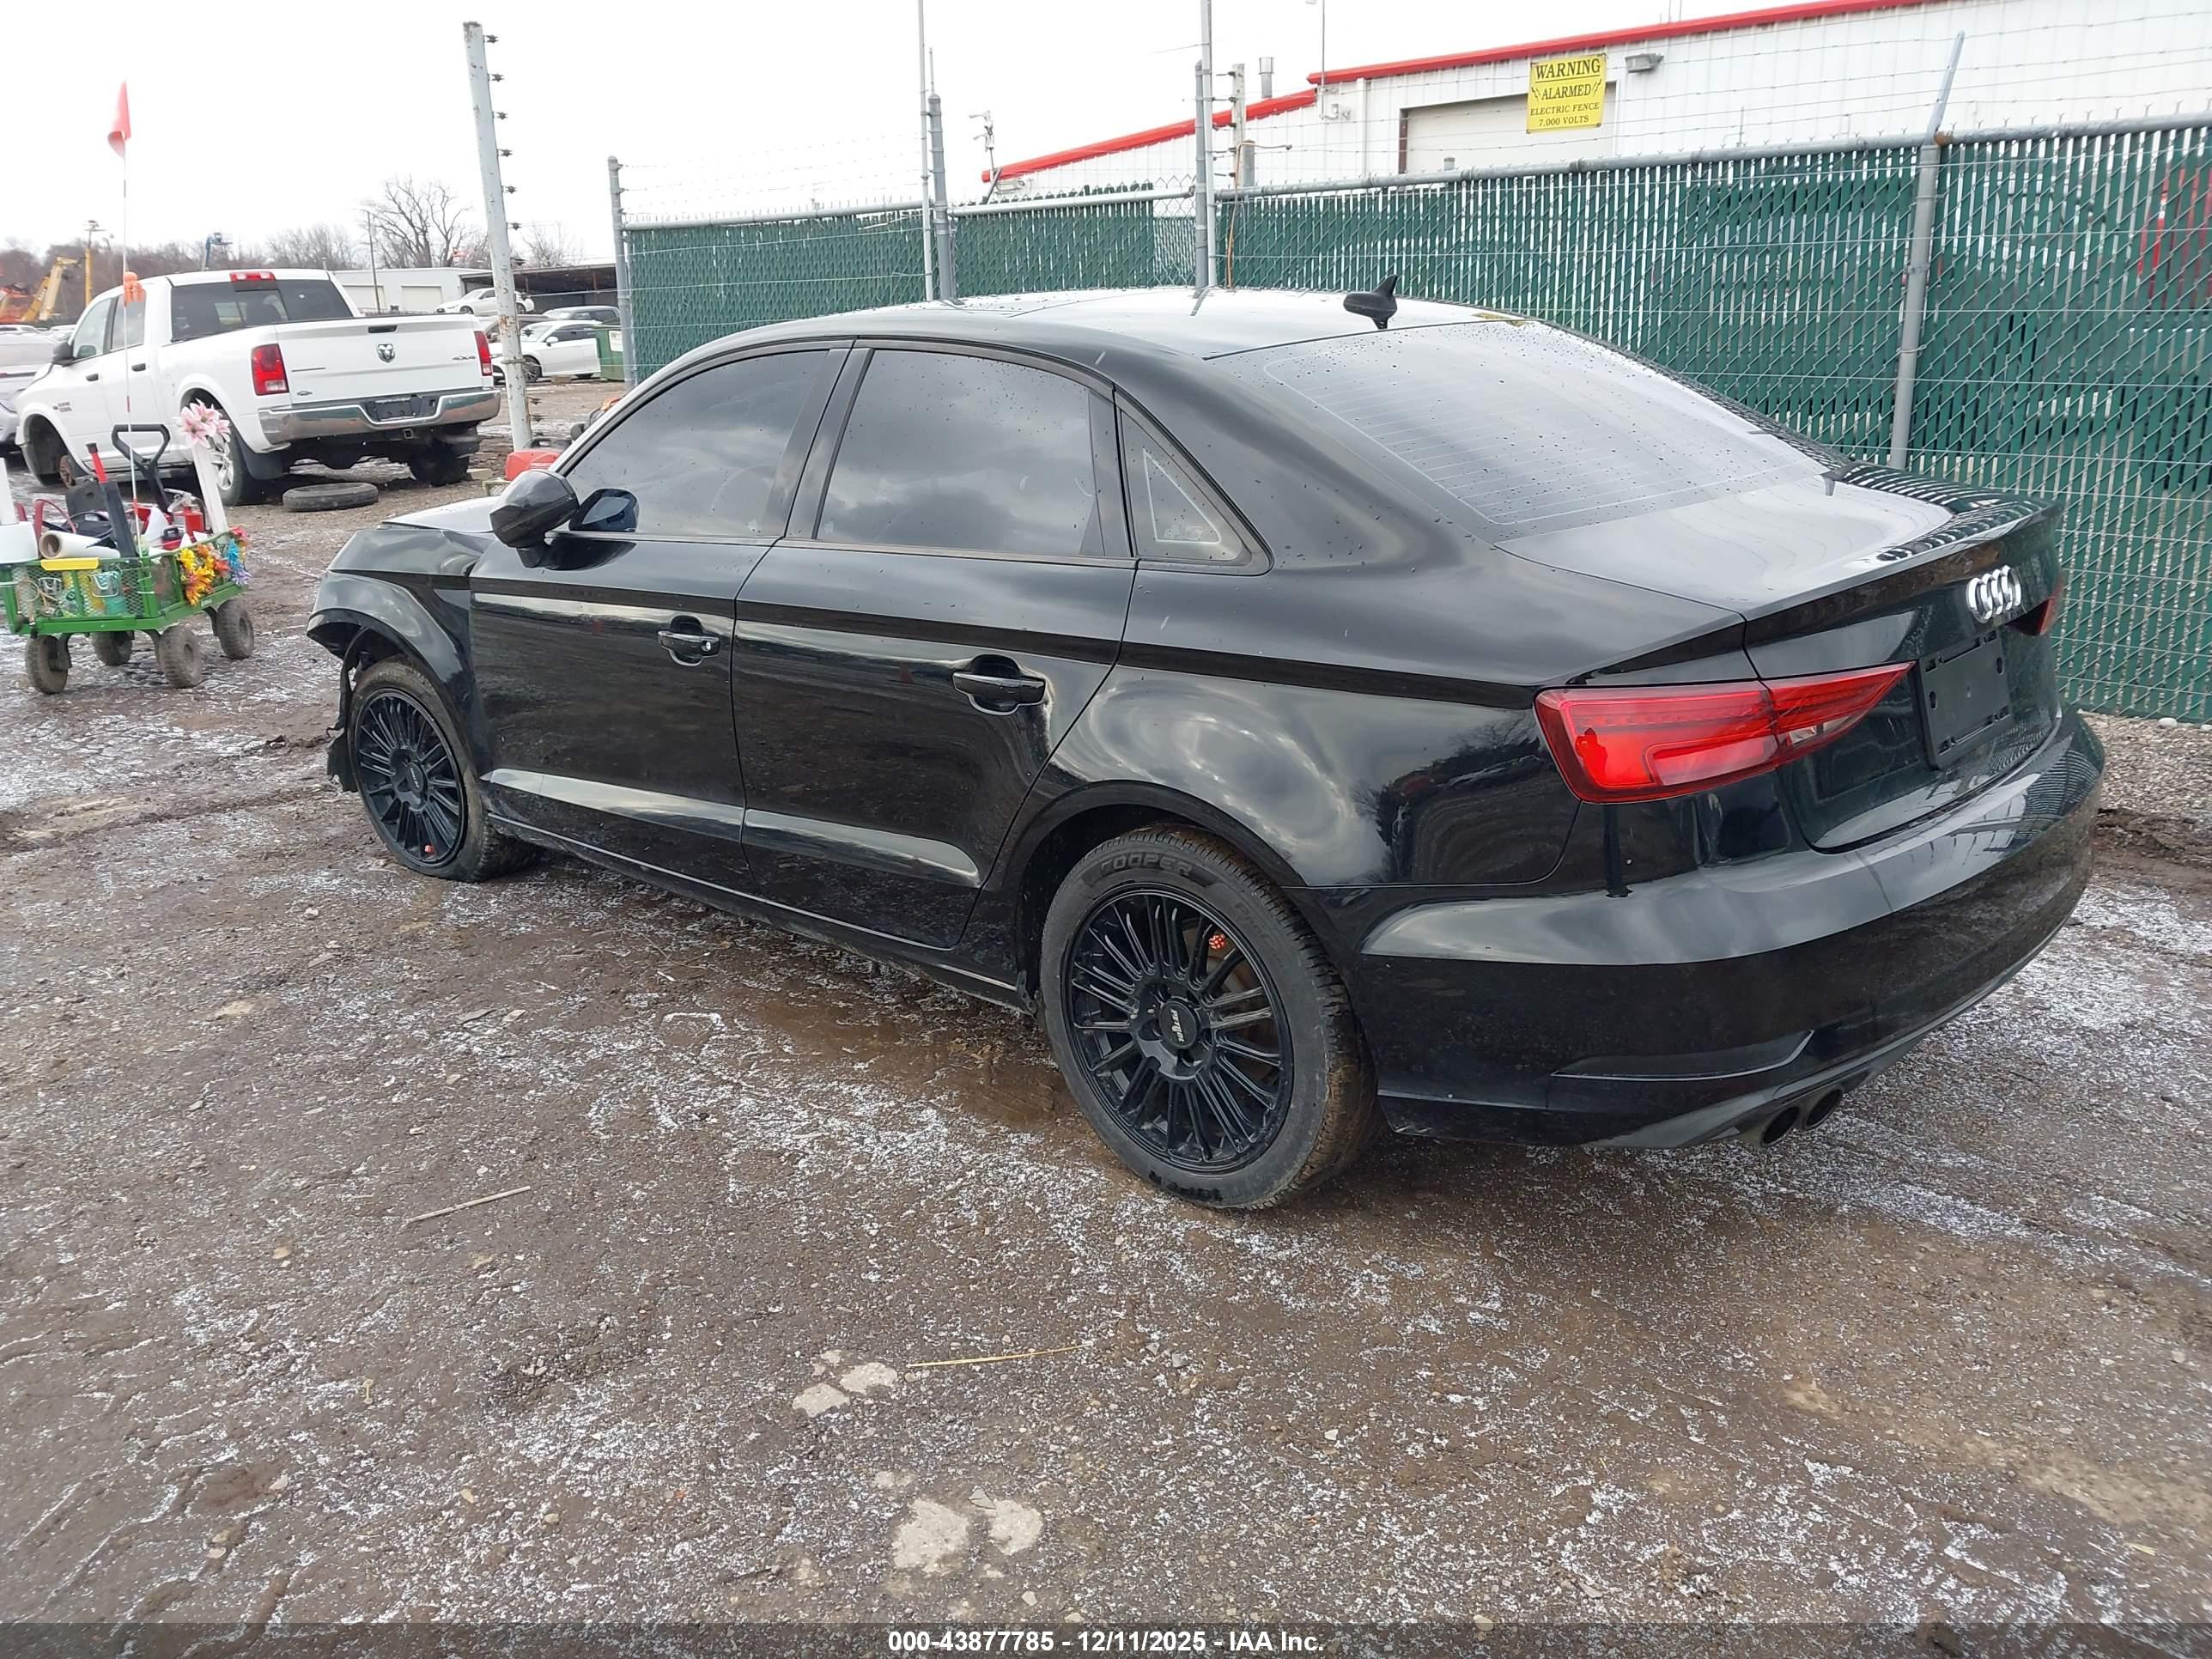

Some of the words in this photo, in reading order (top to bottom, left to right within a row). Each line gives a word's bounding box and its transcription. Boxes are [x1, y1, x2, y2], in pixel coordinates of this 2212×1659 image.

[1535, 58, 1601, 79] WARNING
[1541, 83, 1591, 100] ALARMED
[1530, 105, 1571, 116] ELECTRIC
[1572, 101, 1600, 112] FENCE
[1563, 115, 1589, 124] VOLTS
